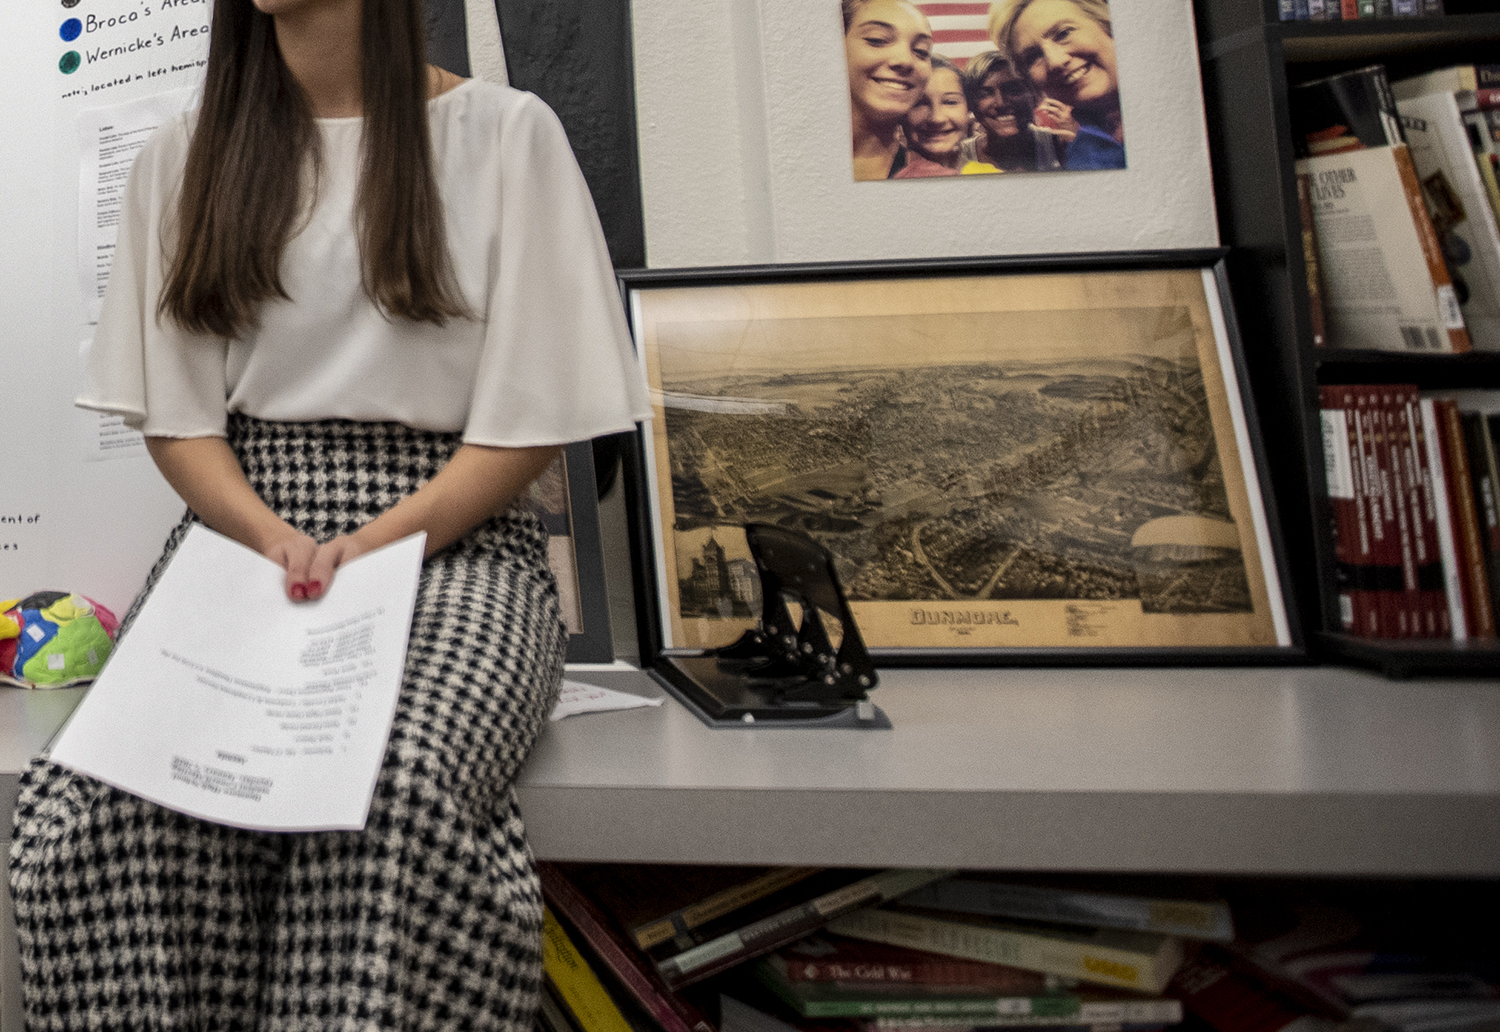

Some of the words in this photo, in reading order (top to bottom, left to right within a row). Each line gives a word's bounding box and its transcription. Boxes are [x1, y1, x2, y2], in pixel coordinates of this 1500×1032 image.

[86, 1, 152, 33] Broca's
[86, 33, 164, 64] Wernicke's
[91, 74, 131, 92] located
[135, 72, 143, 81] in
[171, 59, 207, 73] hemisp
[27, 514, 40, 524] of
